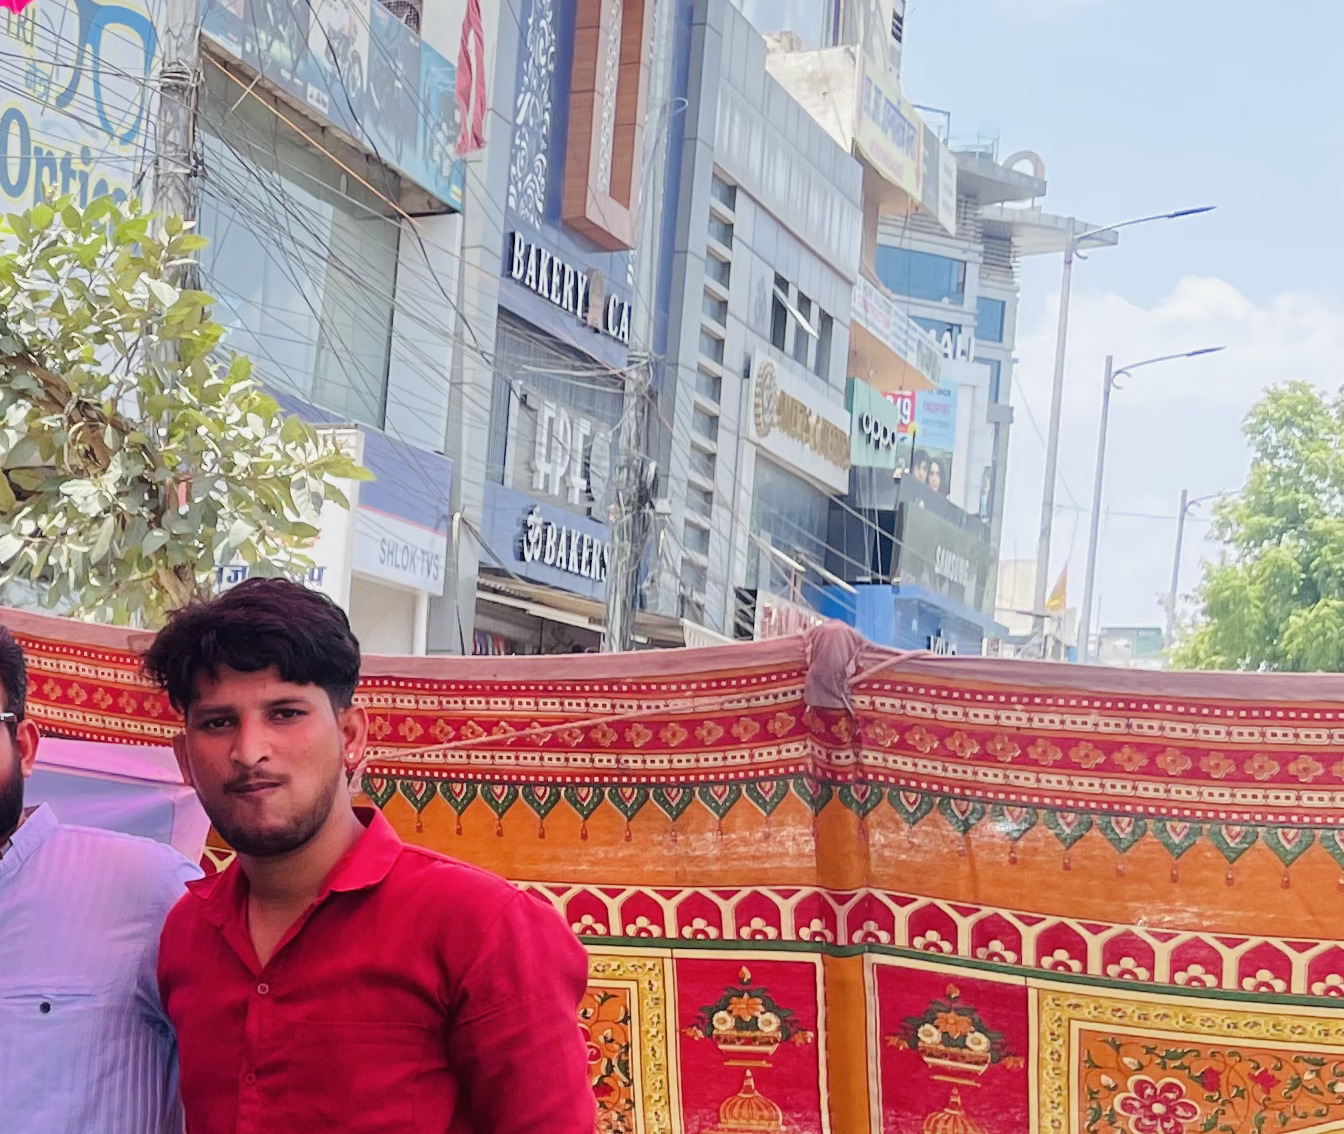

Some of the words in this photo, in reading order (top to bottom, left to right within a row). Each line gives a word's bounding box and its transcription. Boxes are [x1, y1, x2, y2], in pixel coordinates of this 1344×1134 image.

[512, 231, 589, 317] BAKERY
[379, 537, 417, 576] SHLOK
[419, 548, 441, 582] TVS
